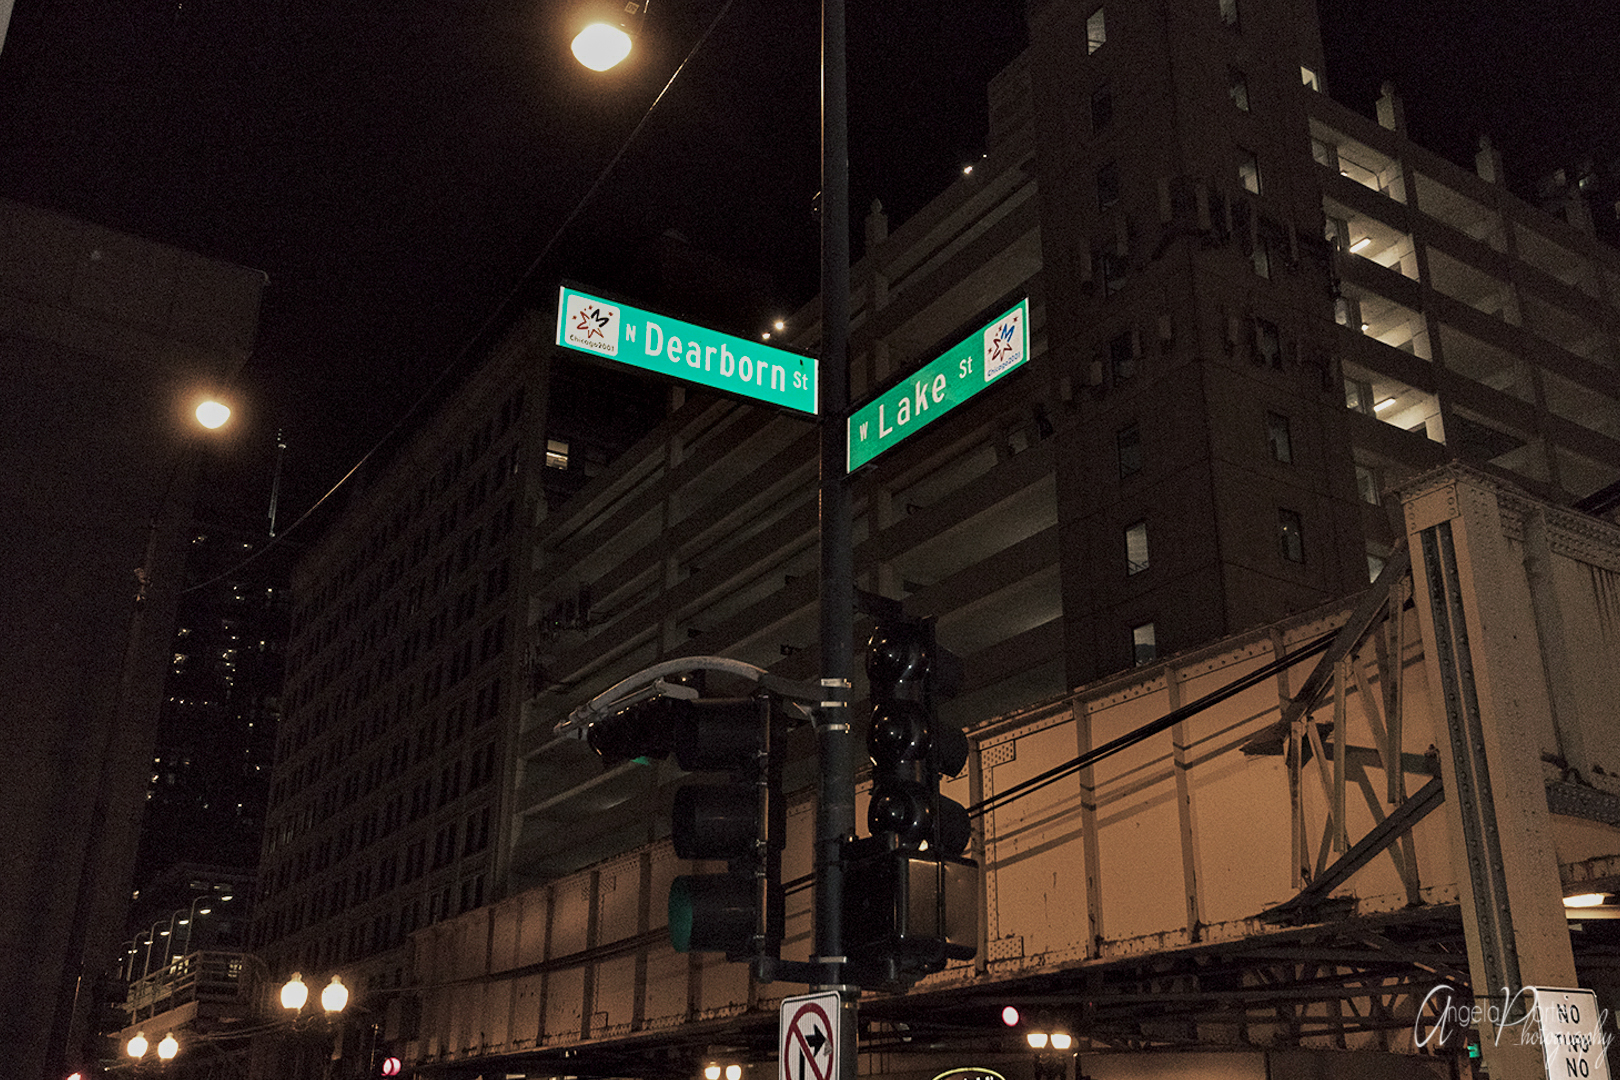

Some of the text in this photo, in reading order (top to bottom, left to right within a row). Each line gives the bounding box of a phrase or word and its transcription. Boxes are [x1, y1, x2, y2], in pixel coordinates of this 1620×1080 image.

[625, 321, 809, 392] N Dearborn St
[859, 356, 973, 442] W Lake St
[1557, 1003, 1580, 1027] NO
[1566, 1058, 1589, 1079] NO
